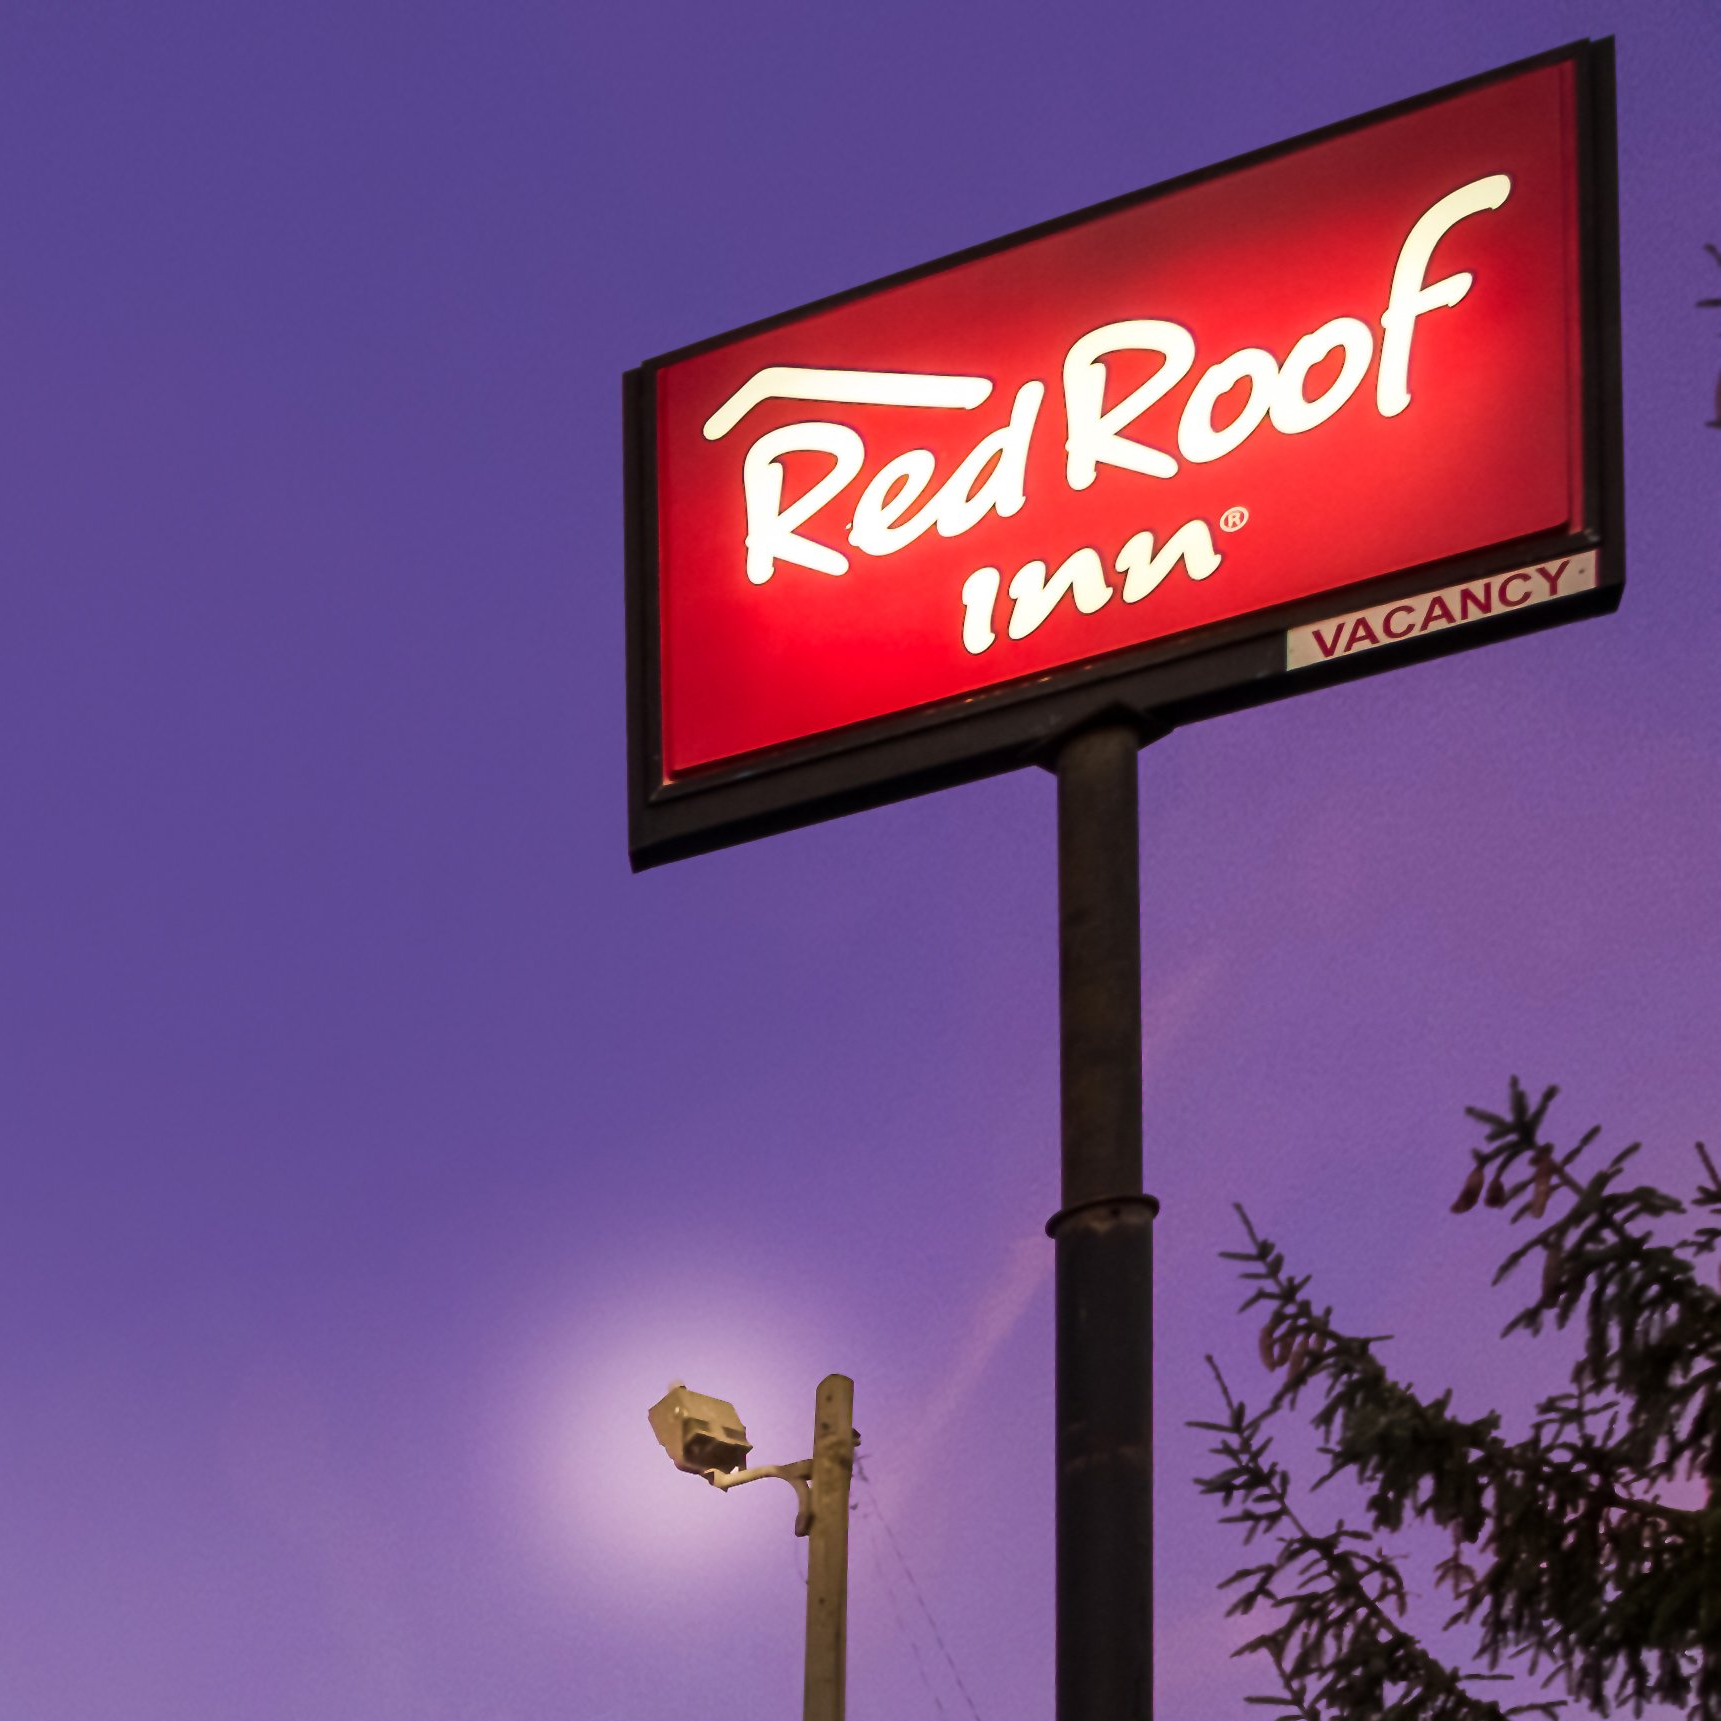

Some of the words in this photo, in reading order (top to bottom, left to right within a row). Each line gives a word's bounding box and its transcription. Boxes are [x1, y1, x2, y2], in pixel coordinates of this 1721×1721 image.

[743, 380, 1045, 585] Red
[1062, 174, 1511, 491] Roof
[1312, 560, 1571, 658] VACANCY
